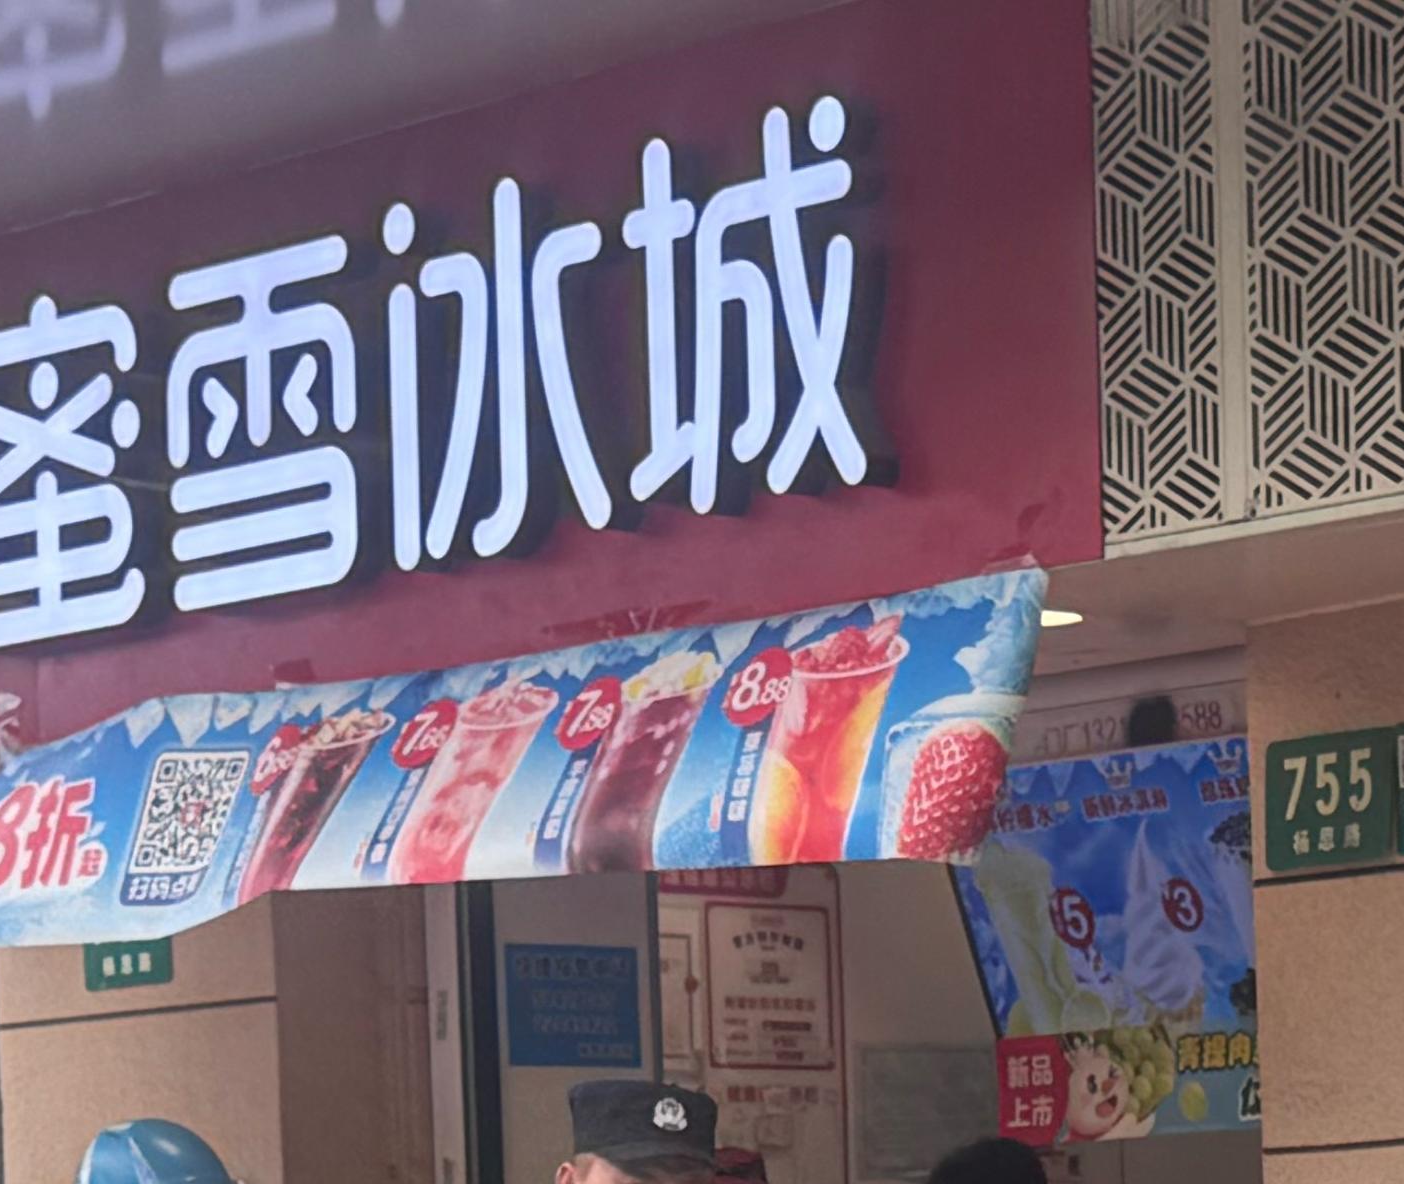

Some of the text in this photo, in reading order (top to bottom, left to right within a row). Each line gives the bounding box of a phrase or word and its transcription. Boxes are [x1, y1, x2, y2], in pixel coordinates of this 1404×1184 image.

[1284, 747, 1373, 821] 755
[1064, 895, 1089, 940] 5
[1174, 887, 1196, 929] 3
[1007, 1056, 1054, 1088] 新品
[1178, 1033, 1259, 1073] 青提肉
[1007, 1095, 1054, 1129] 上市
